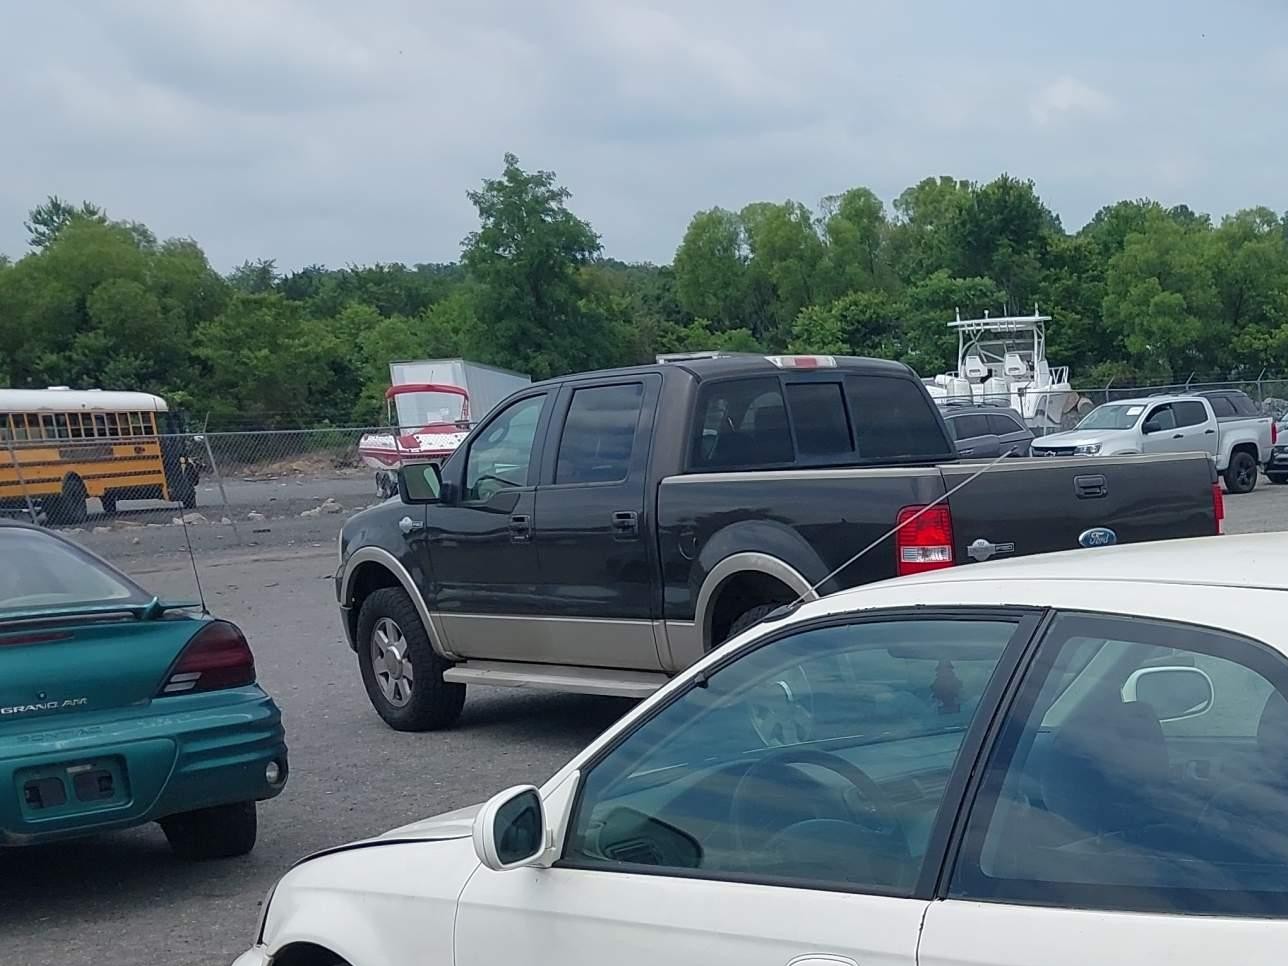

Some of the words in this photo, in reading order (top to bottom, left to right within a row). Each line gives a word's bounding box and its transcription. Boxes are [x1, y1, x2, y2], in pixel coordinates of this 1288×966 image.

[1089, 532, 1109, 545] Ford
[0, 701, 59, 715] GRAND
[62, 697, 88, 708] AM
